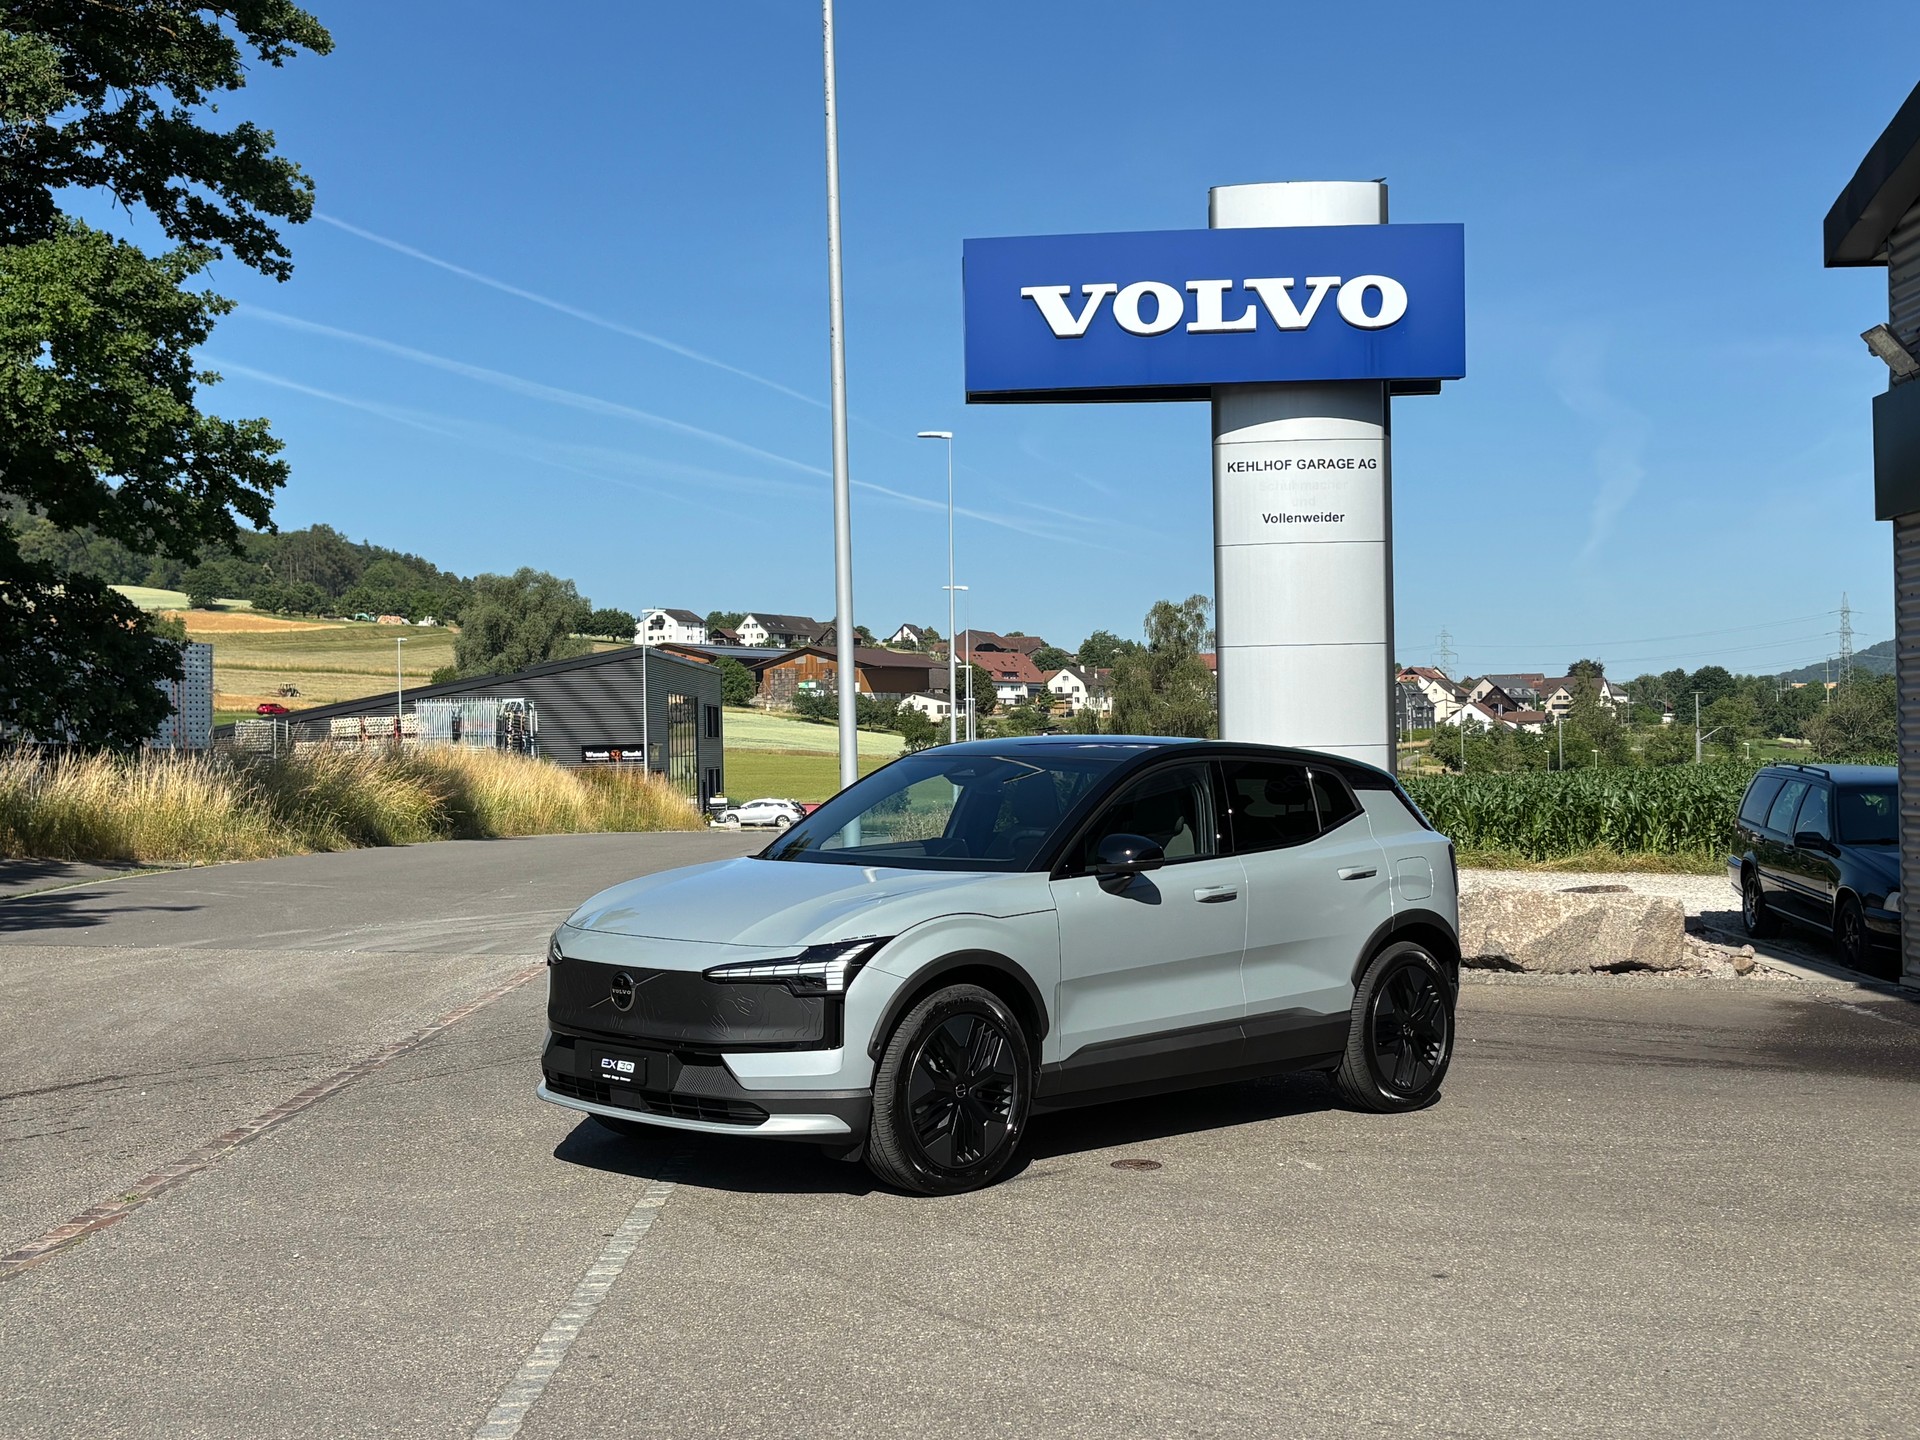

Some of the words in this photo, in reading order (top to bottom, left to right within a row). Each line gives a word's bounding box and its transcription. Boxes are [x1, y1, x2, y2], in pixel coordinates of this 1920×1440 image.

[1020, 274, 1409, 338] VOLVO
[1227, 459, 1293, 473] KEHLHOF
[1296, 458, 1355, 470] GARAGE
[1358, 458, 1378, 470] AG
[1262, 511, 1346, 524] Vollenweider
